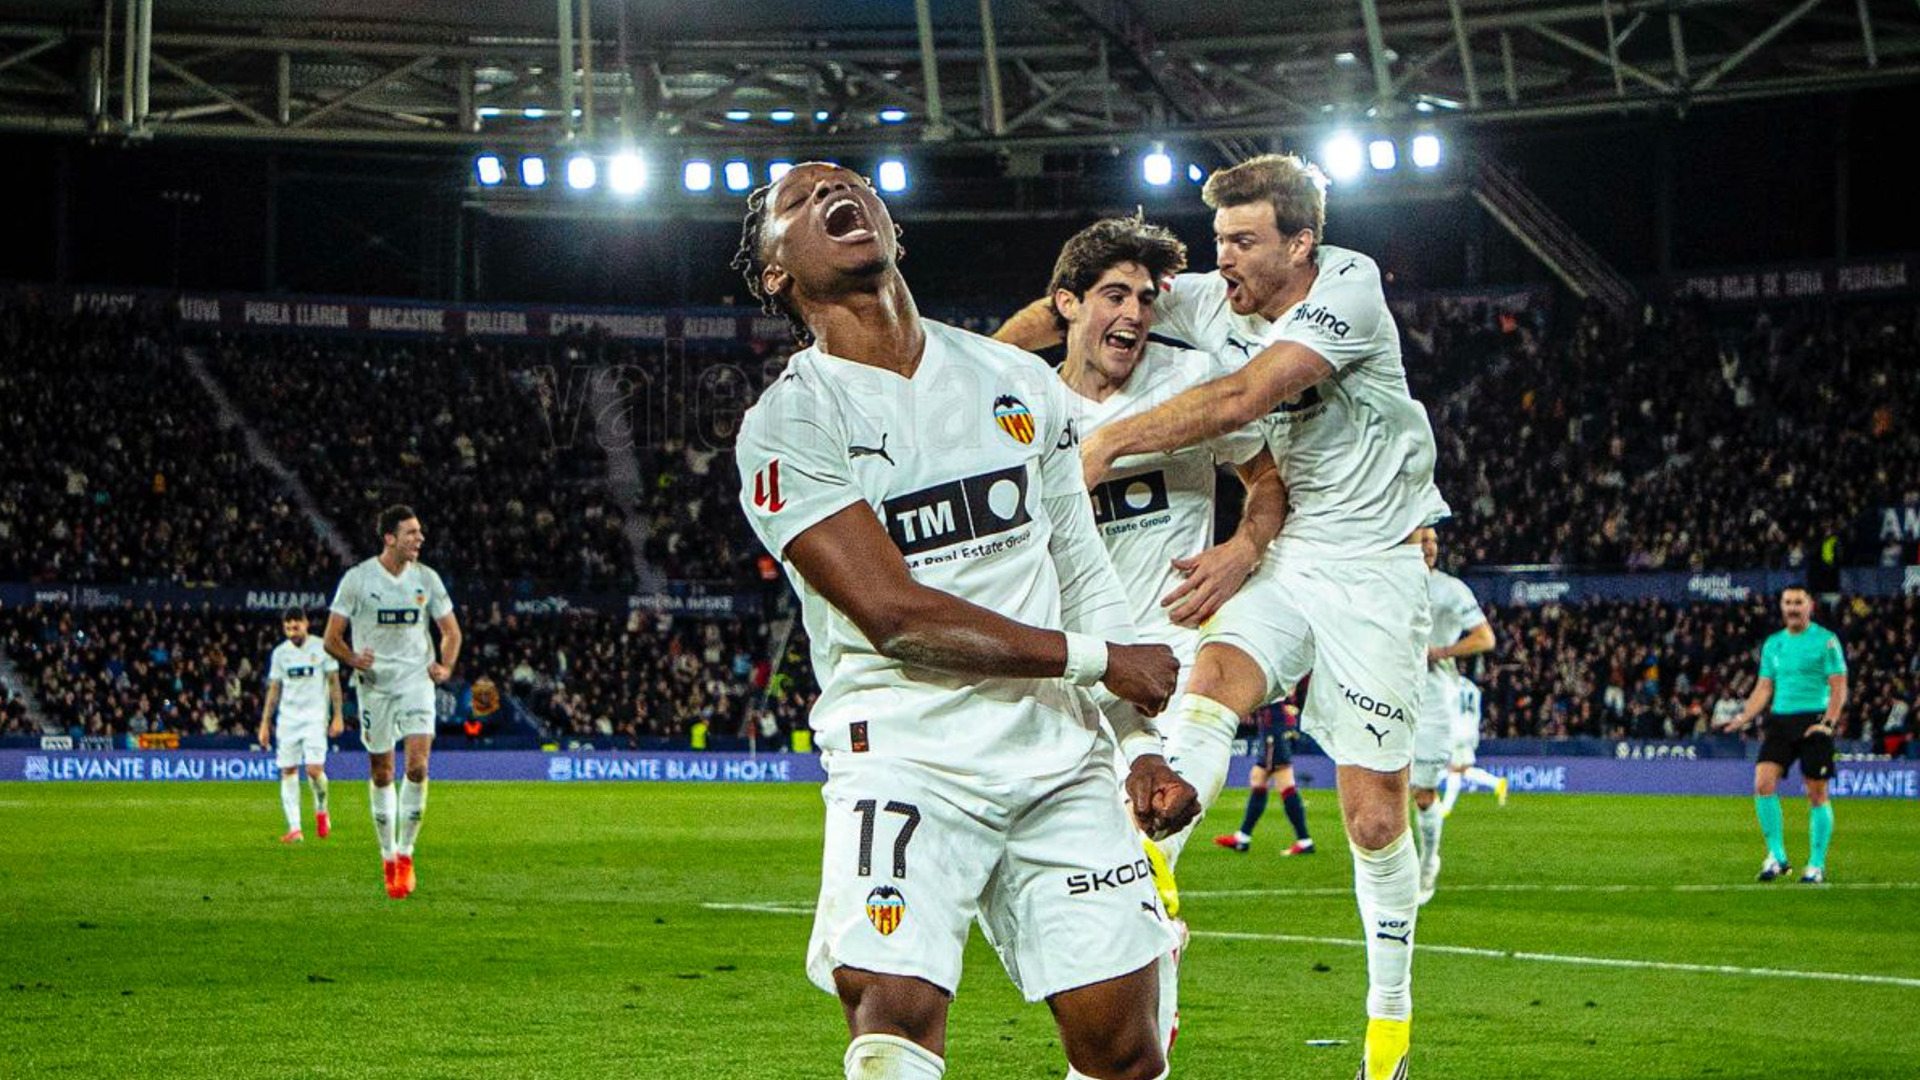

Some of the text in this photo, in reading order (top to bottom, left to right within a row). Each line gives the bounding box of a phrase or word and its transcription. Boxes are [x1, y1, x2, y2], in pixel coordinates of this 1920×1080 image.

[896, 501, 956, 543] TM
[1105, 514, 1172, 536] Estate Group
[53, 757, 278, 780] LEVANTE BLAU HOME
[574, 758, 661, 780] LEVANTE
[666, 758, 718, 780] BLAU
[1508, 766, 1566, 790] HOME
[1828, 769, 1918, 796] LEVANTE
[853, 799, 921, 879] 17
